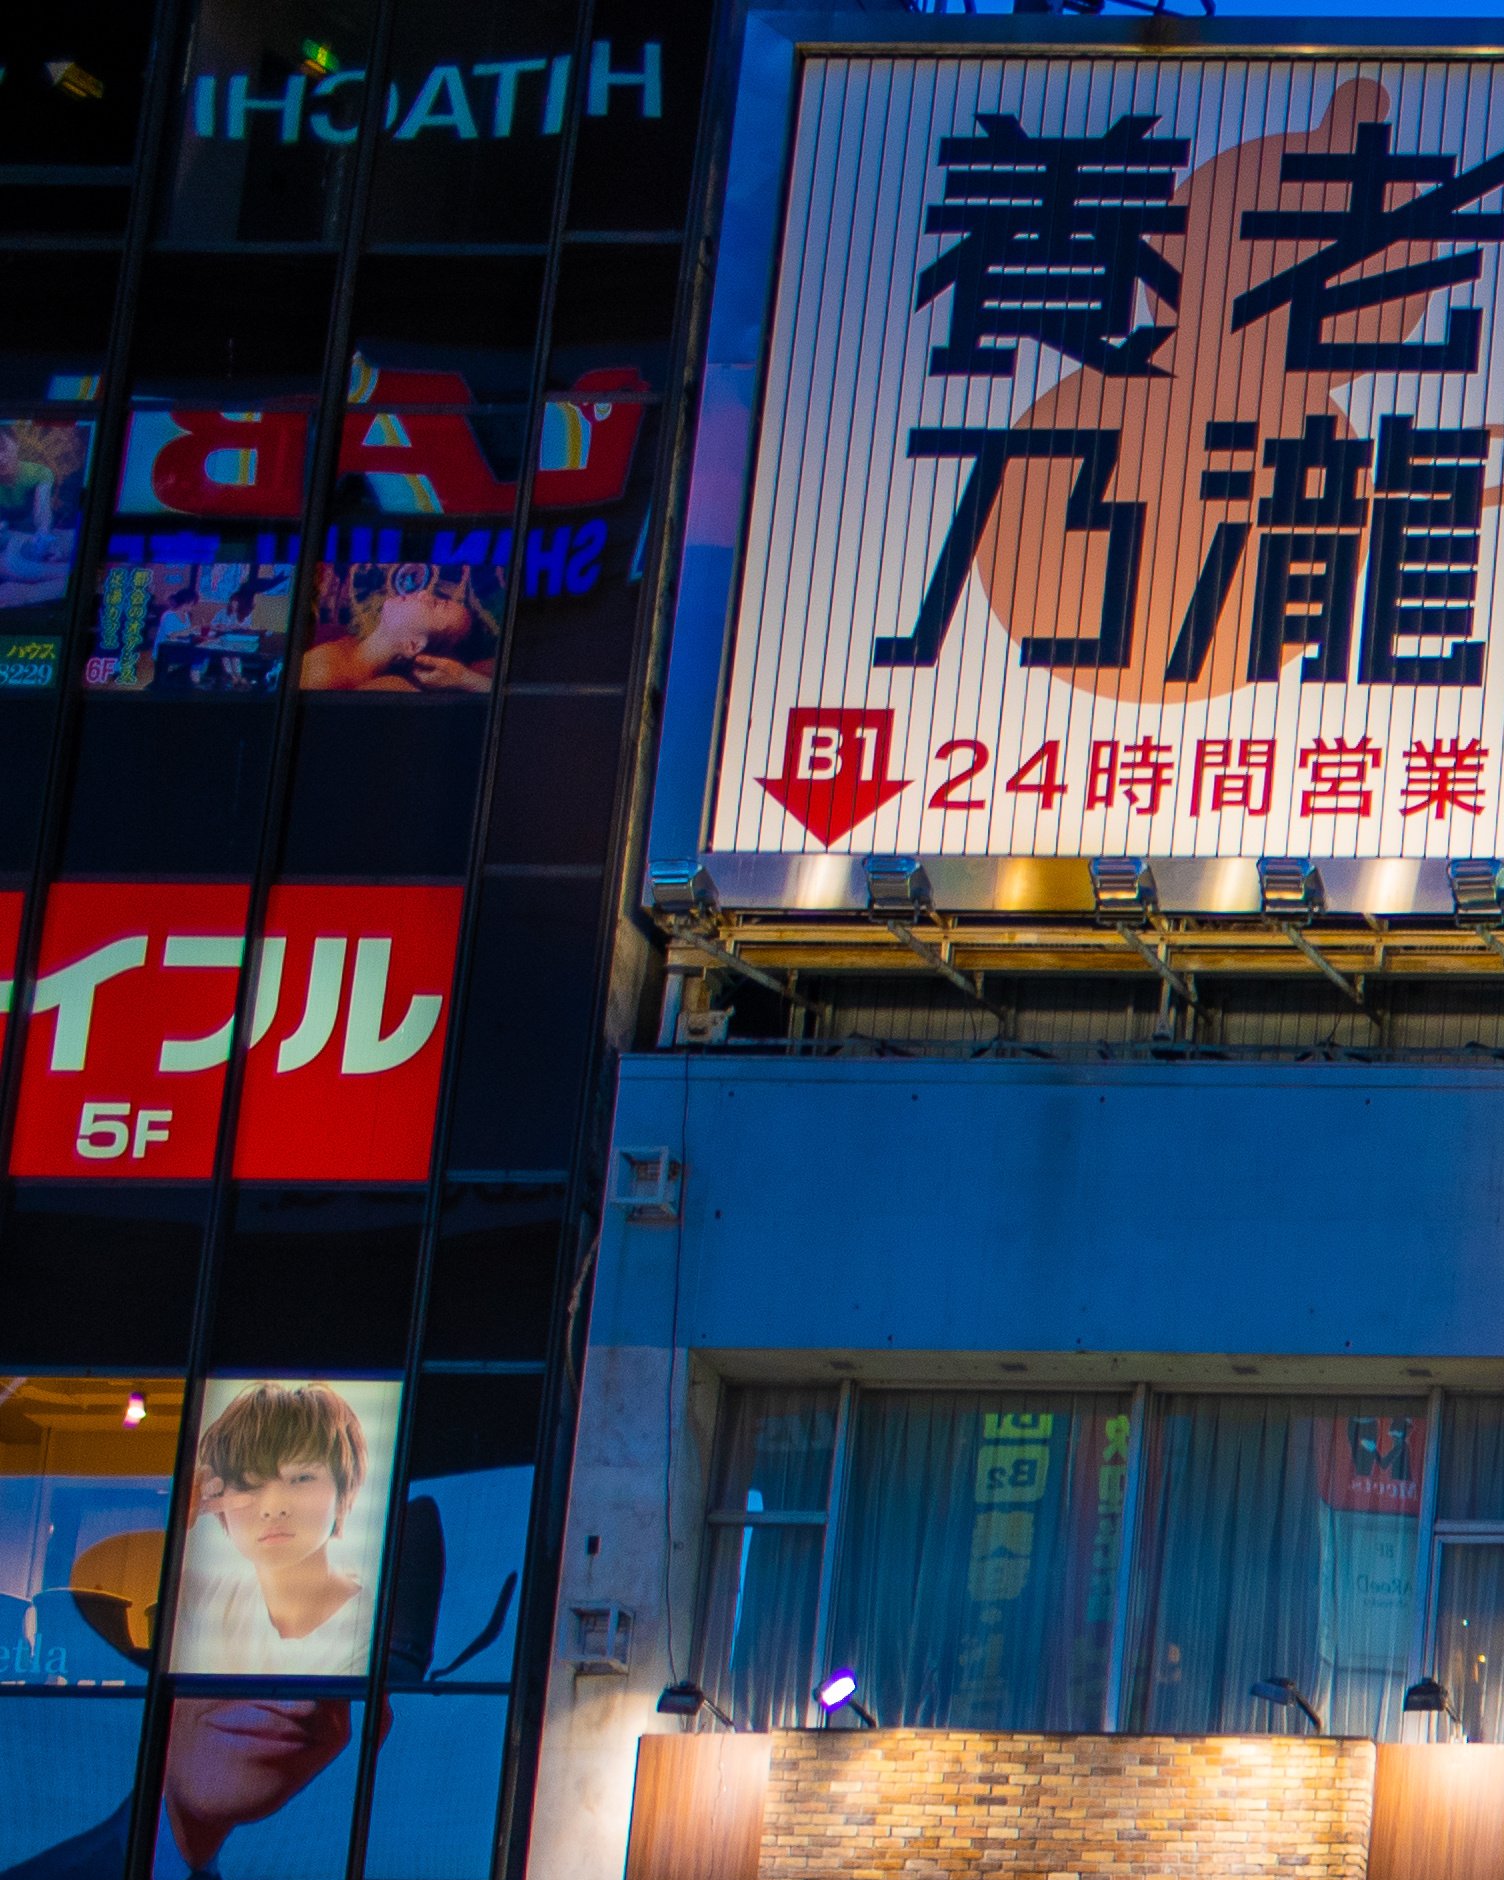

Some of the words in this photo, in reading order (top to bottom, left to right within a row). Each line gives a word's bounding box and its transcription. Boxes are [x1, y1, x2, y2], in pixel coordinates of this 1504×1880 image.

[872, 413, 1490, 688] 乃瀧
[85, 656, 117, 684] 6F
[797, 726, 883, 781] B1
[76, 1101, 173, 1159] 5F
